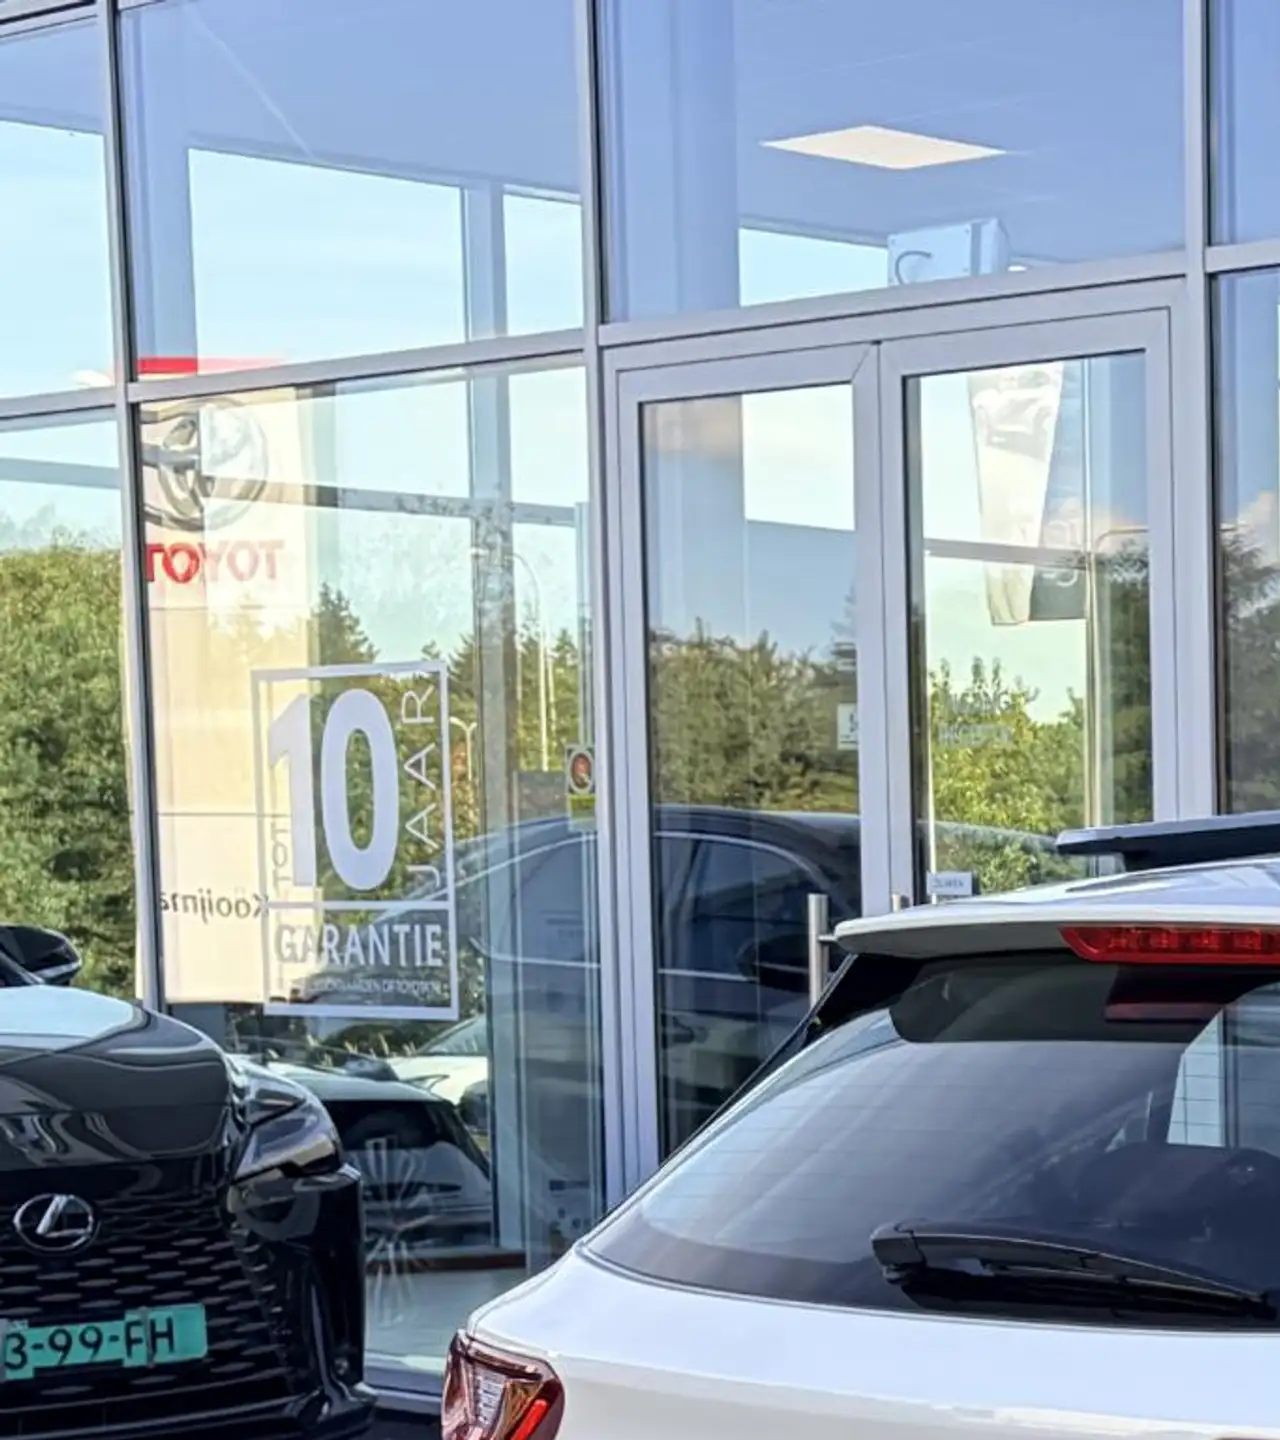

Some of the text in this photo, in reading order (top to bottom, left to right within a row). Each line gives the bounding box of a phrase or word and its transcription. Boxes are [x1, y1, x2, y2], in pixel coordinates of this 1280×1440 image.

[269, 688, 399, 891] 10
[401, 684, 441, 888] JAAR
[274, 923, 443, 967] GARANTIE
